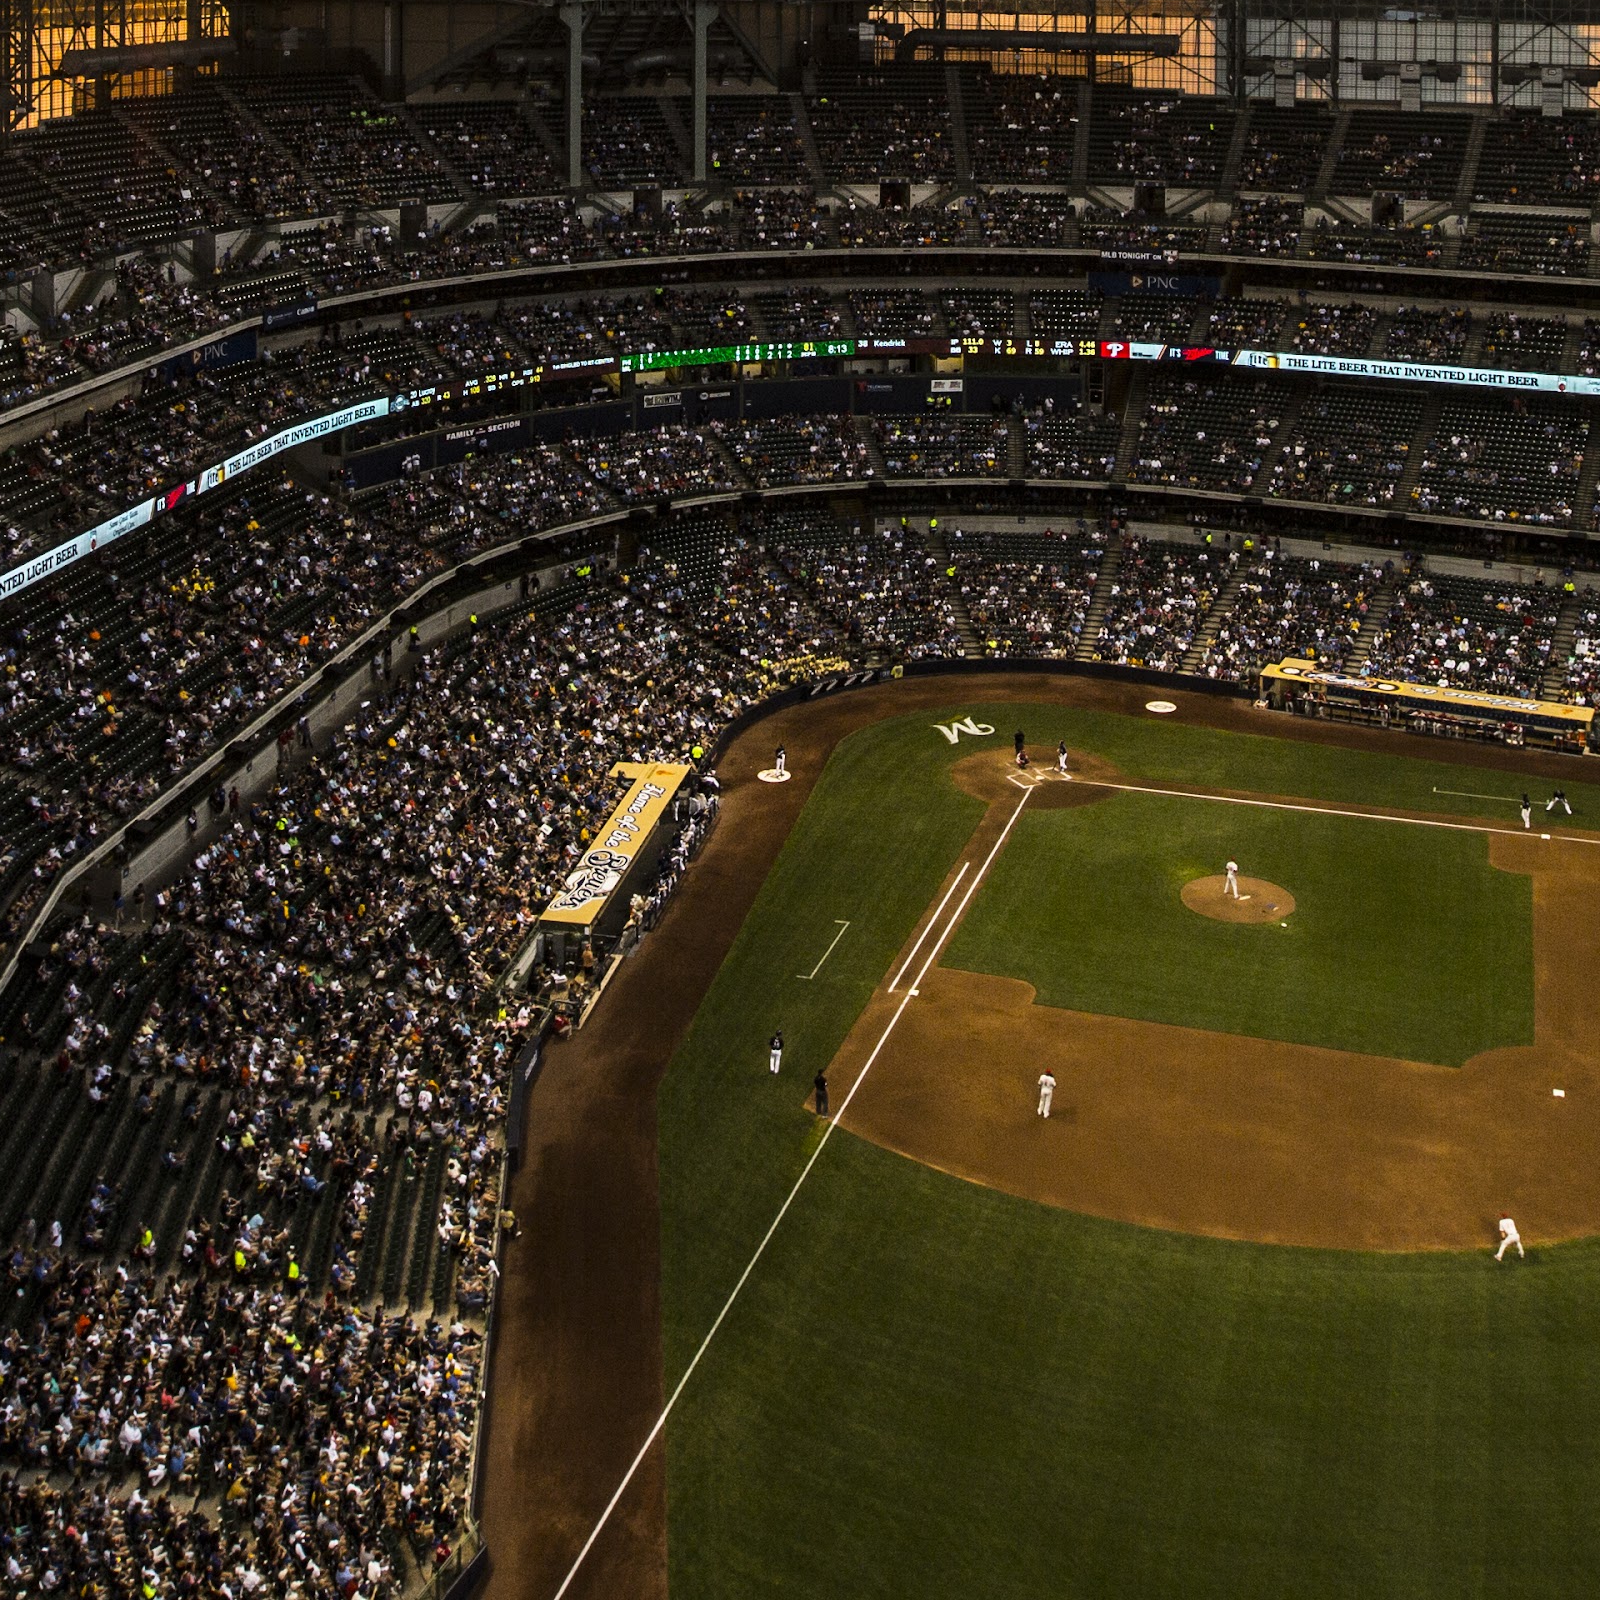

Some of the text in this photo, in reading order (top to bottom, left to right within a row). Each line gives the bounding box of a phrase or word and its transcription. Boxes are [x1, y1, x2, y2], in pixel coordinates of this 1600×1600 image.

[1101, 251, 1117, 259] MLB
[1118, 252, 1150, 260] TONIGHT
[1147, 276, 1179, 290] PNC
[204, 342, 228, 361] PNC
[828, 344, 847, 354] 8:13
[874, 339, 905, 347] Kendrick
[962, 338, 984, 346] 111.0
[1286, 357, 1539, 387] THE LITE BEER THAT INVENTED LIGHT BEER
[229, 405, 376, 474] THE LITE BEER THAT INVENTED LIGHT BEER
[446, 429, 475, 441] FAMILY
[487, 420, 521, 433] SECTION
[27, 556, 54, 581] LIGHT
[55, 544, 79, 566] BEER
[1443, 690, 1542, 711] Welcome
[628, 783, 666, 814] Home
[615, 815, 641, 832] of
[605, 830, 631, 848] the
[548, 849, 633, 911] Brewers
